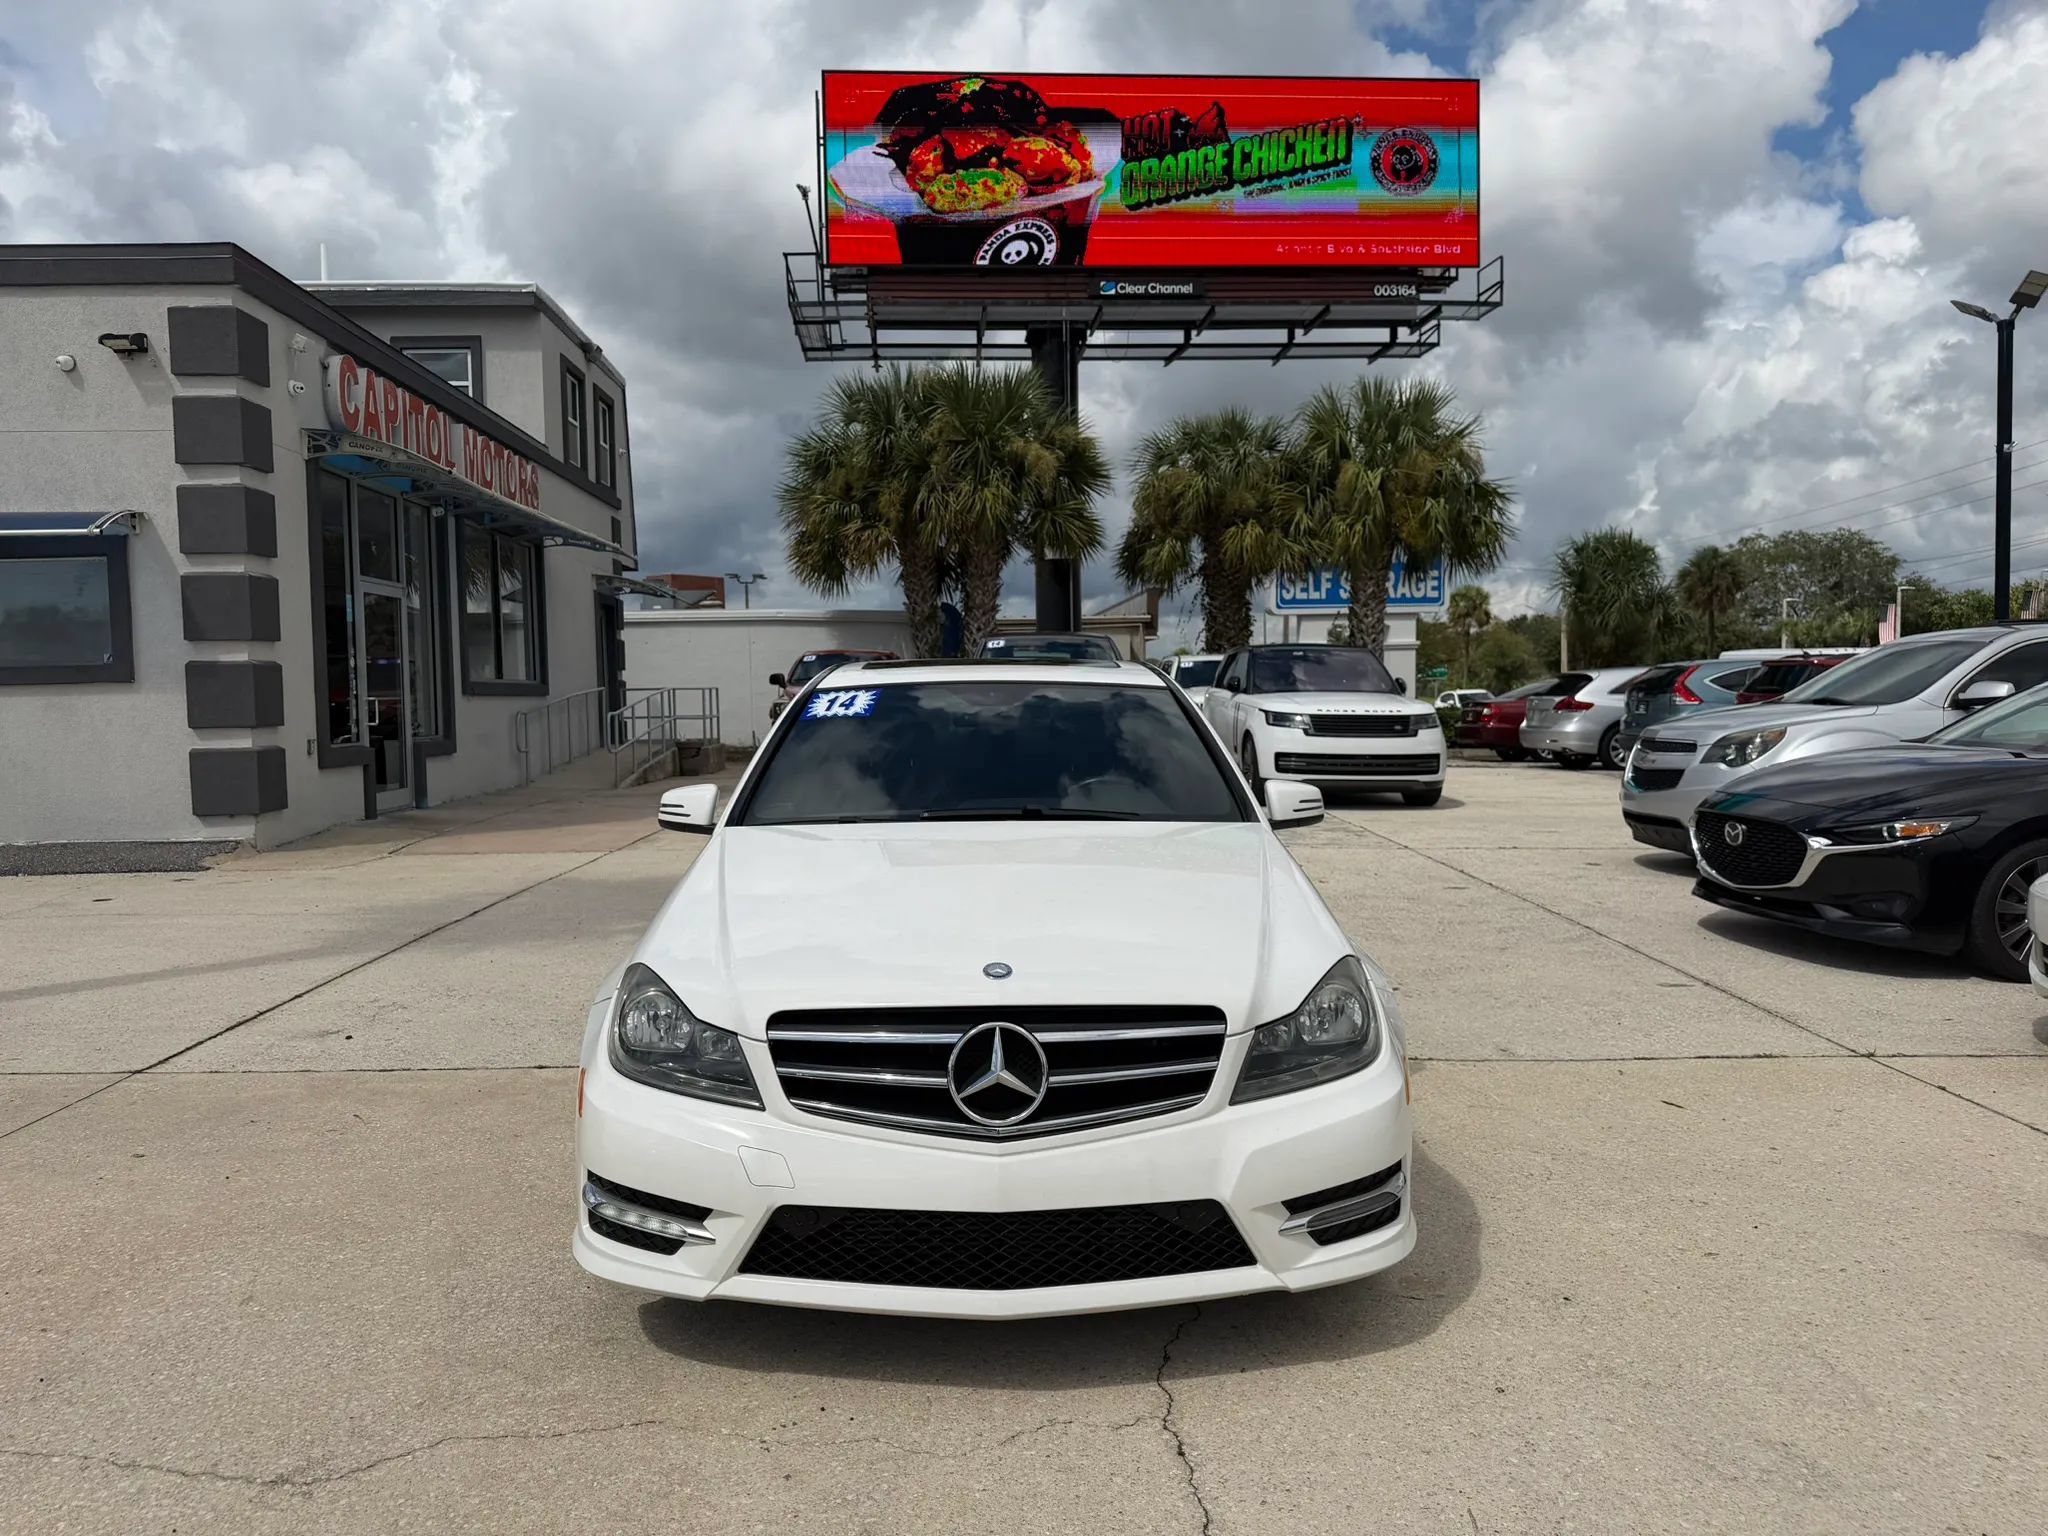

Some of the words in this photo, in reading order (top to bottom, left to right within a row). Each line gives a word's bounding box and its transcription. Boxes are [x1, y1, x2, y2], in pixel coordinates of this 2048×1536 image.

[1121, 141, 1229, 208] ORANGE
[1232, 117, 1348, 184] CHICKEN
[978, 228, 1012, 261] PANDA
[1014, 221, 1055, 245] EXPRESS
[1434, 244, 1461, 254] Blvd
[1116, 282, 1147, 294] Clear
[1148, 282, 1193, 294] Channel
[1374, 284, 1417, 297] 003164
[338, 354, 457, 470] CAPITOL
[462, 424, 541, 512] MOTORS
[1281, 570, 1332, 601] SELF
[1339, 569, 1440, 600] SRAGE
[825, 693, 858, 712] 14
